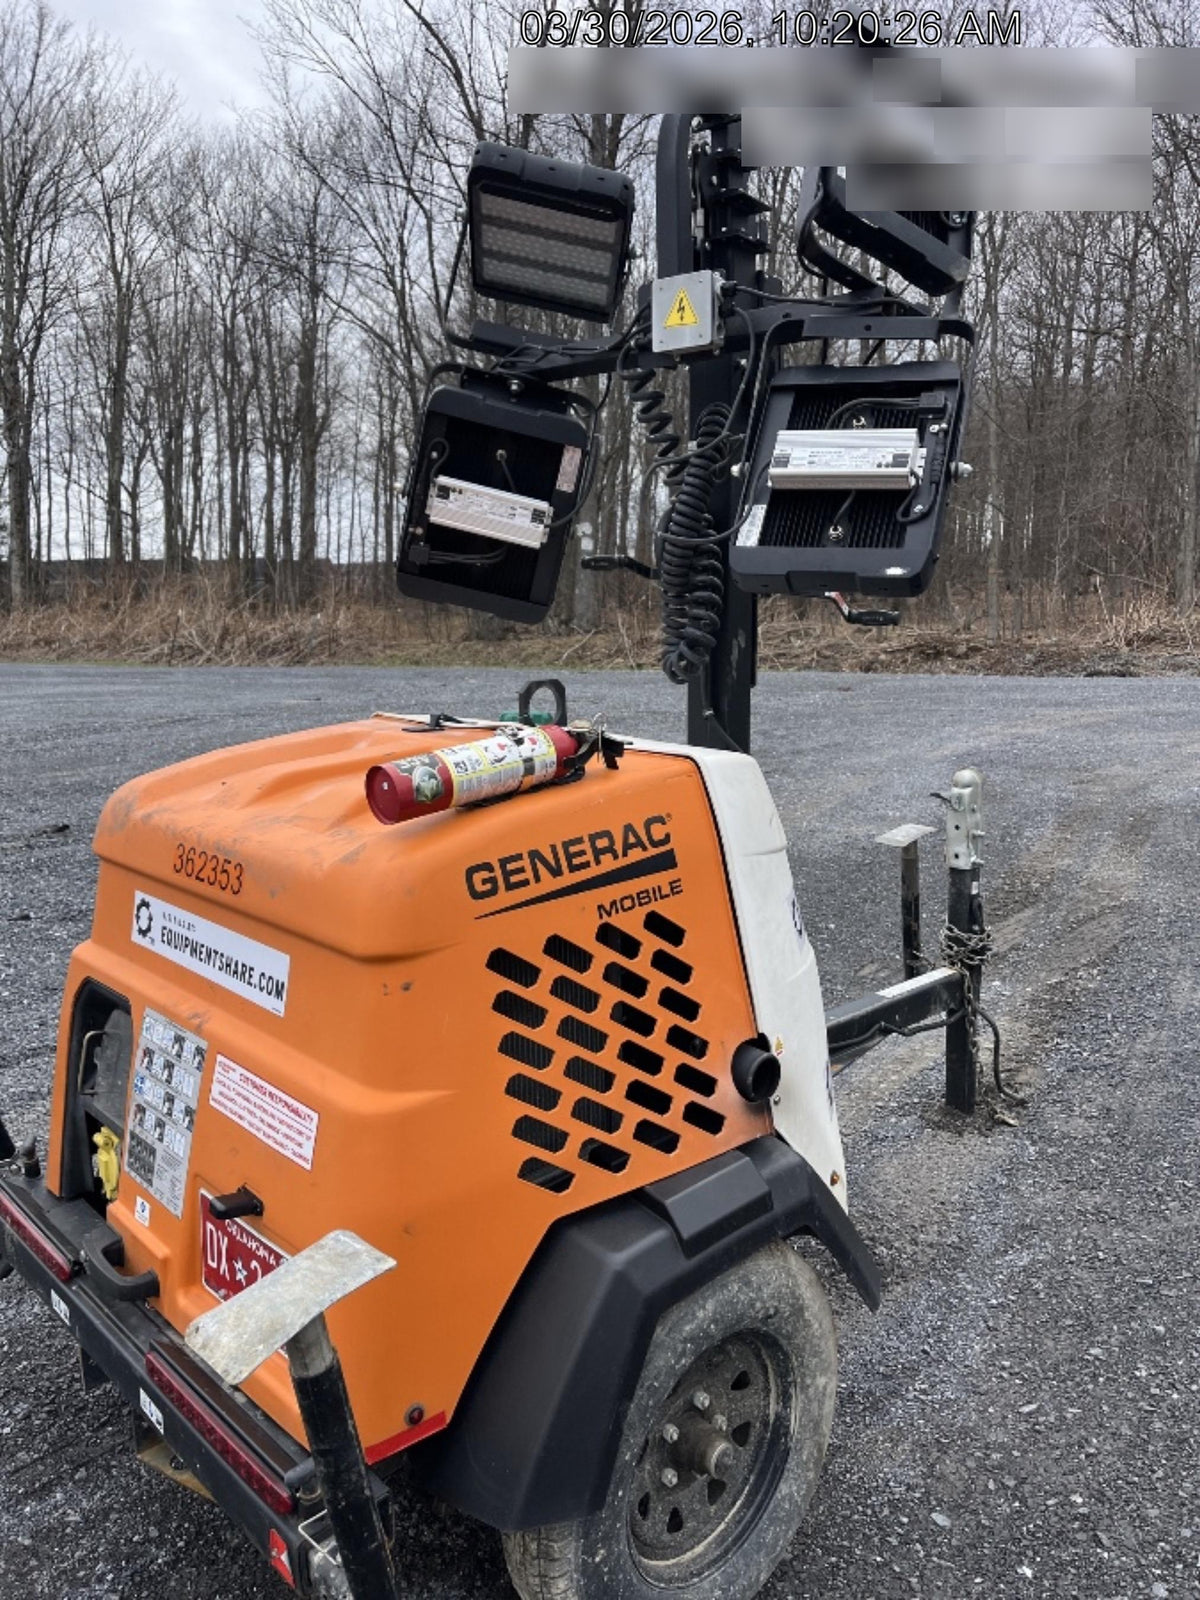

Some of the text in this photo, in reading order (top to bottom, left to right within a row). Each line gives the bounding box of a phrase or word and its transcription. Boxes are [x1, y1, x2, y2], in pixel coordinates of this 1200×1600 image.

[173, 843, 244, 895] 362353
[465, 815, 671, 901] GENERAC
[597, 878, 683, 919] MOBILE
[160, 926, 285, 1001] EQUIPMENTSHARE.COM
